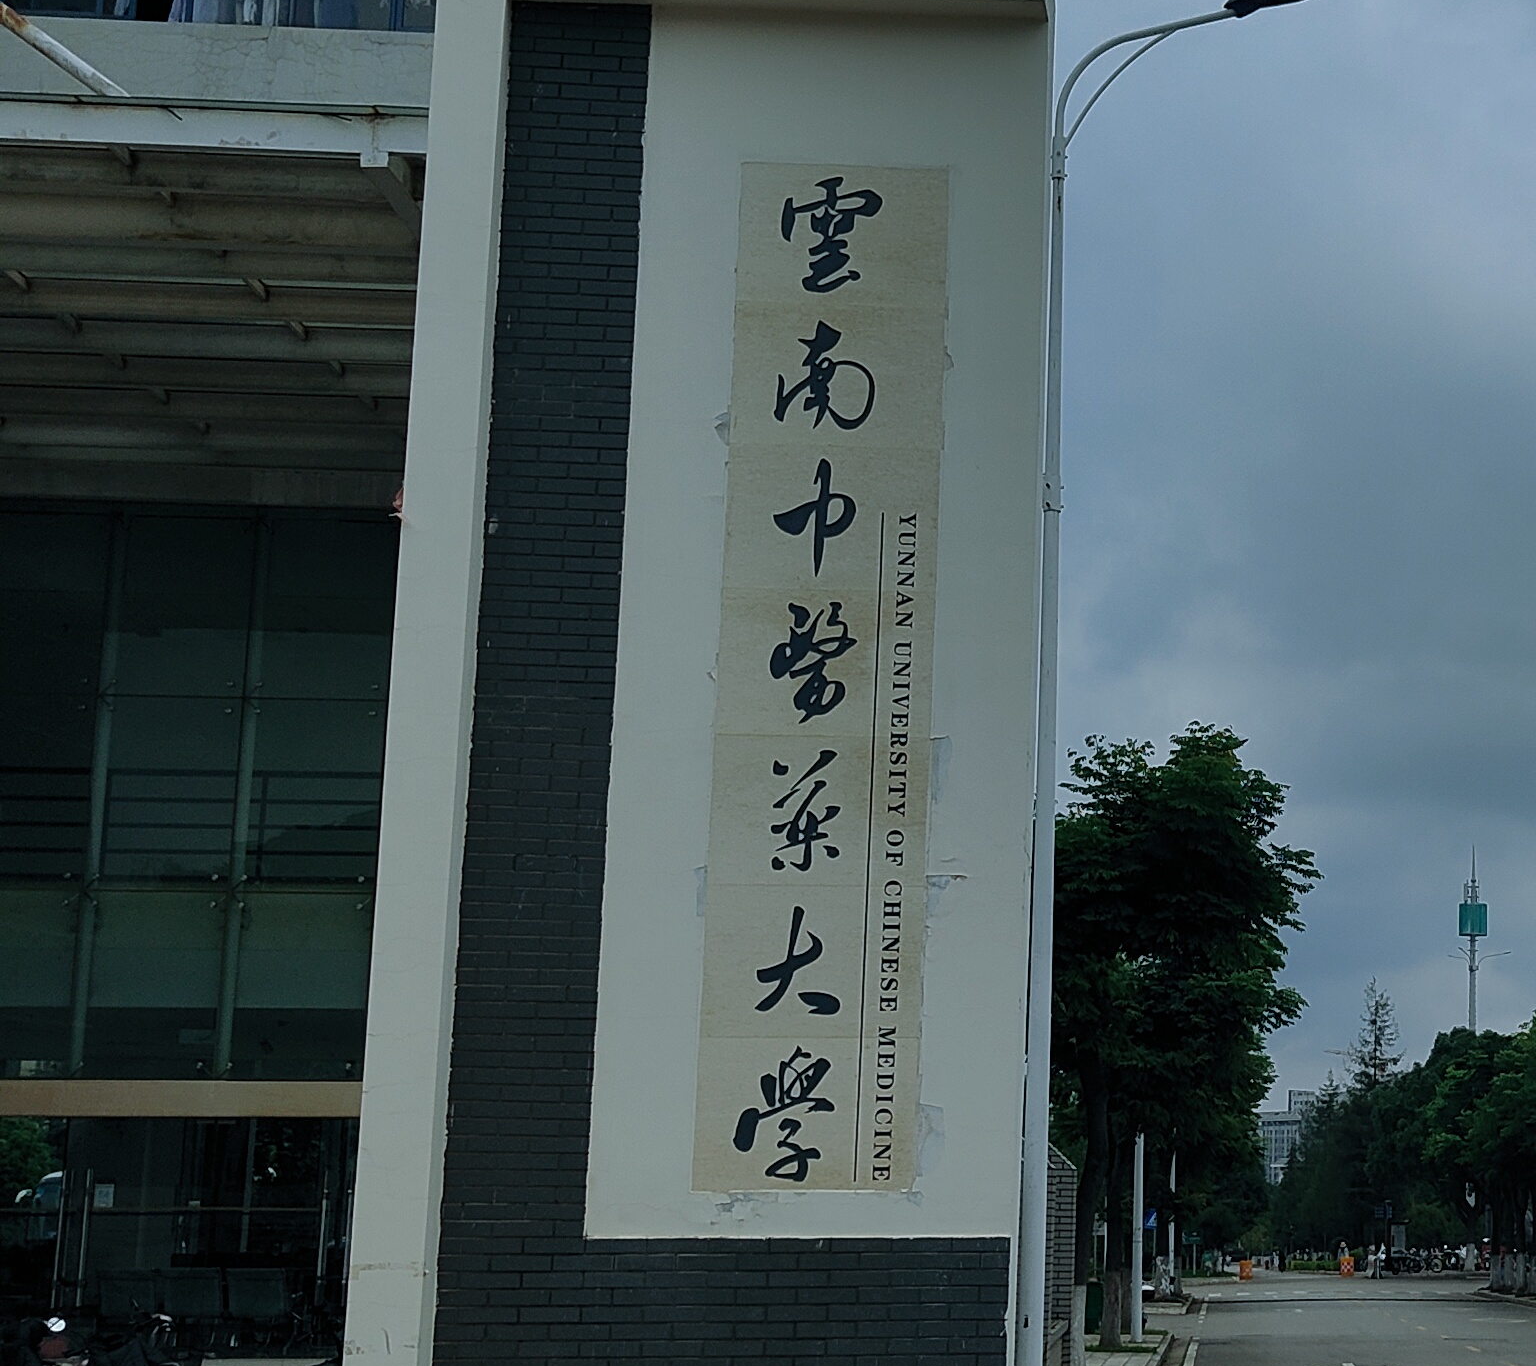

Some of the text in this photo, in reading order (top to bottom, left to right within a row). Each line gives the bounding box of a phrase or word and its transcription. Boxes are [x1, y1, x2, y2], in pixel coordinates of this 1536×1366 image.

[871, 512, 917, 1181] YUNNAN UNIVERSITY OF CHINESE MEDICINE
